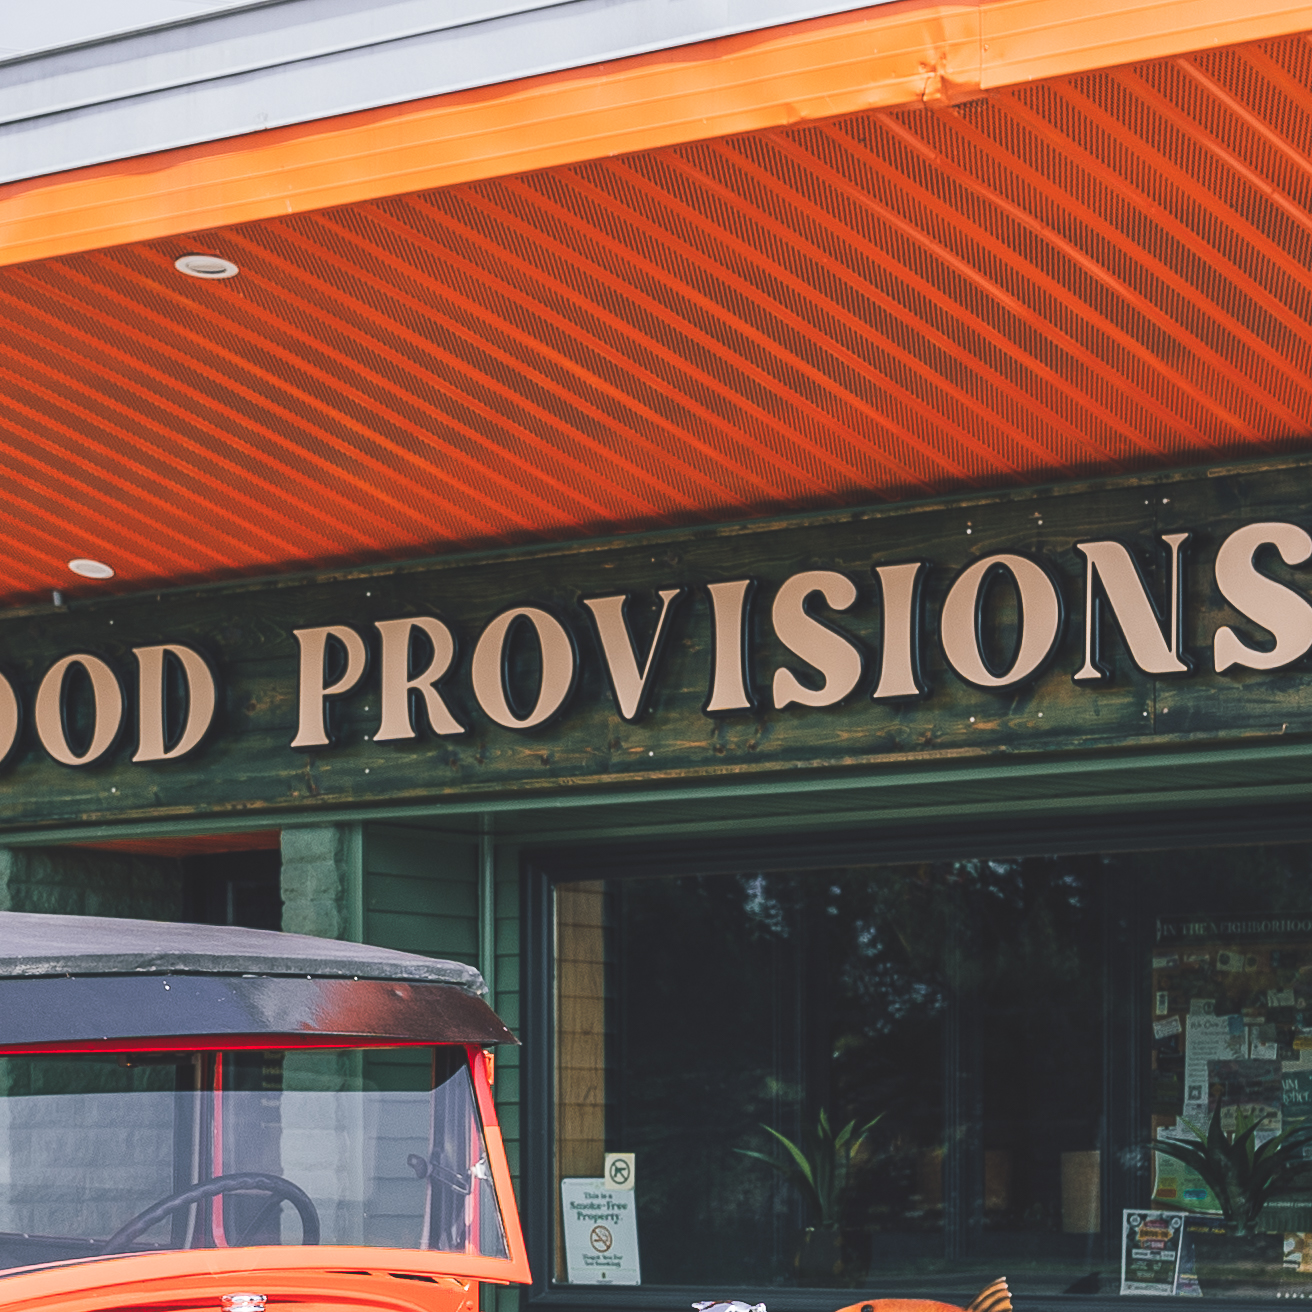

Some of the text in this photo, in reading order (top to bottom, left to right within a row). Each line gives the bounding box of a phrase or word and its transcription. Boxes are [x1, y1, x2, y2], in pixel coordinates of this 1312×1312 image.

[1180, 921, 1207, 936] THE
[584, 1191, 599, 1199] This
[569, 1200, 628, 1211] Smoke-Free
